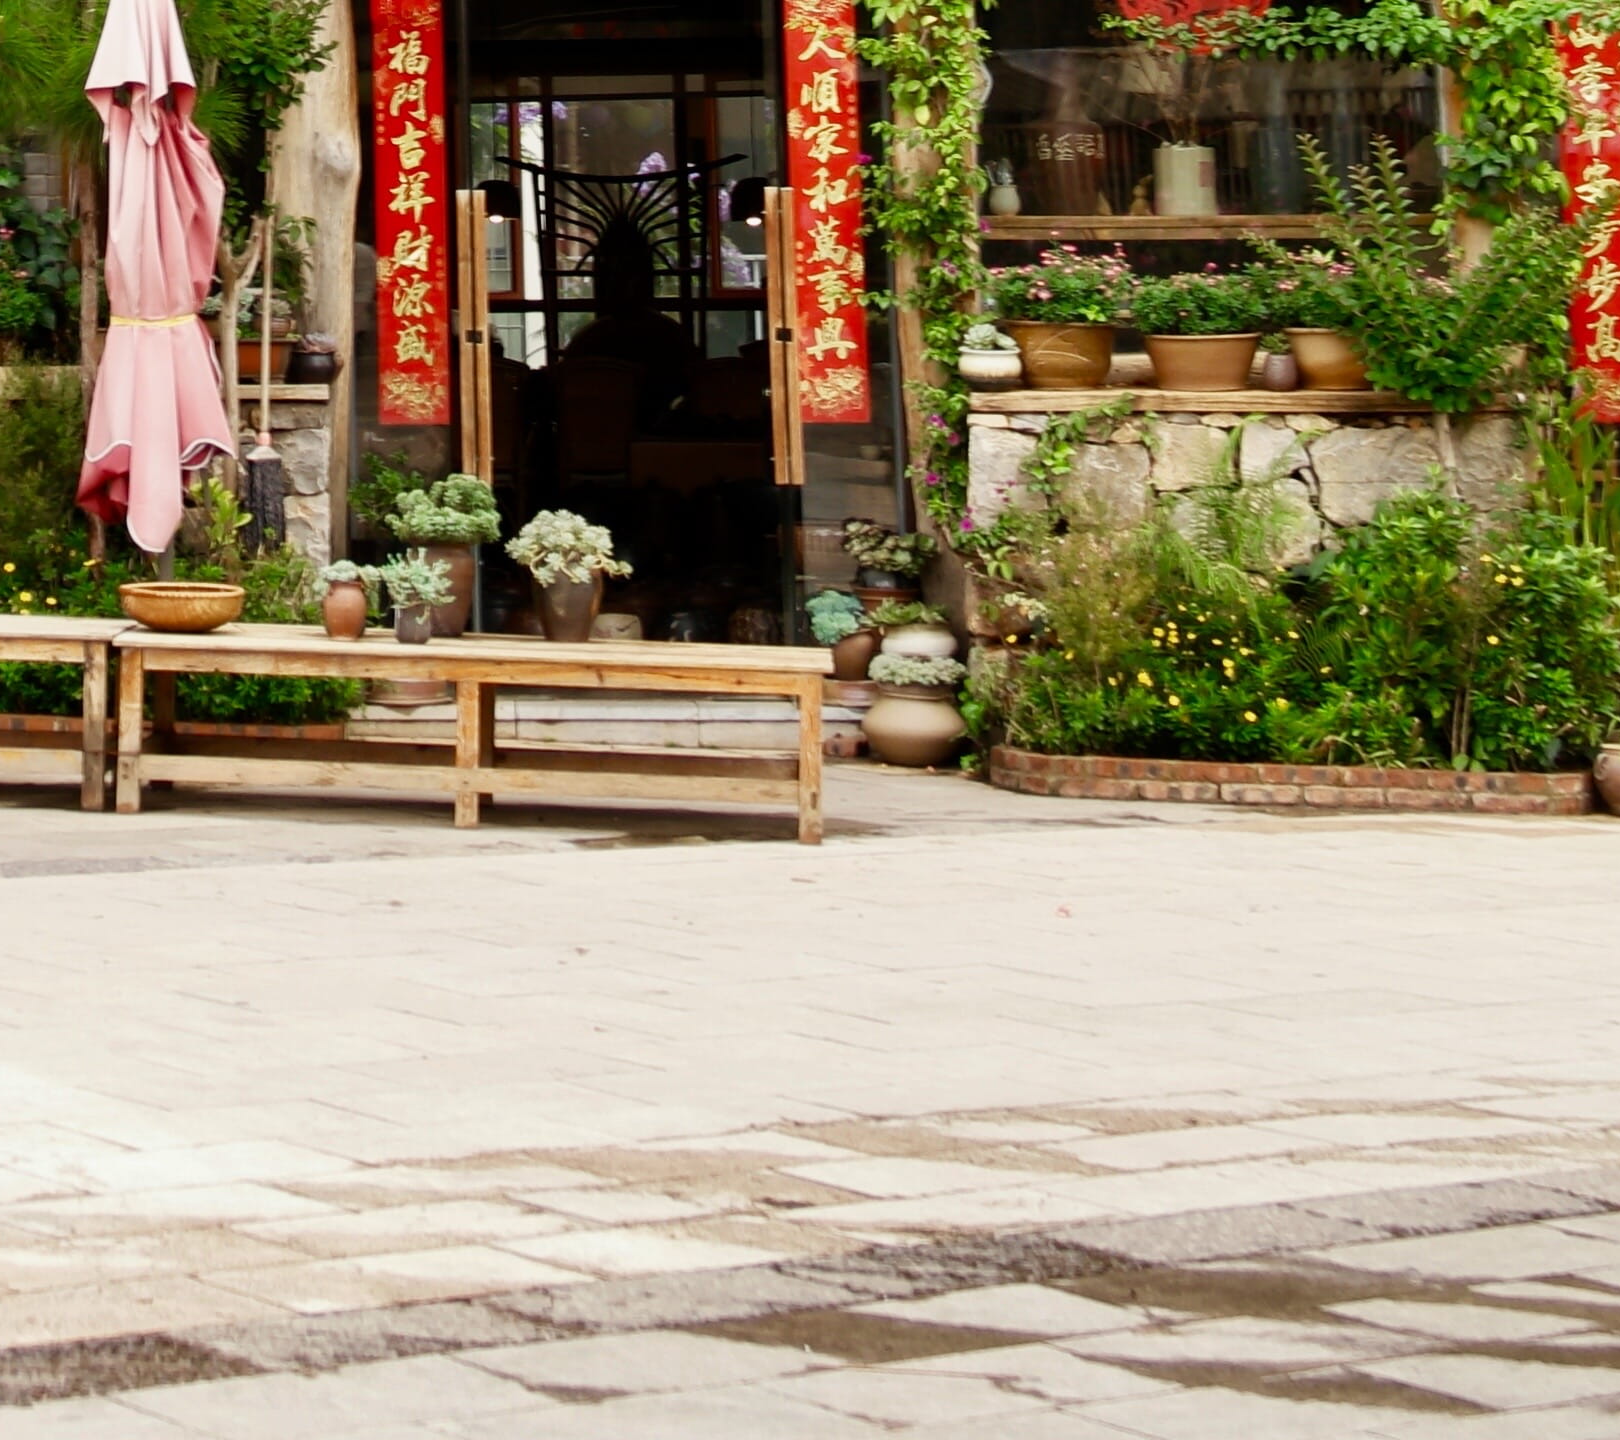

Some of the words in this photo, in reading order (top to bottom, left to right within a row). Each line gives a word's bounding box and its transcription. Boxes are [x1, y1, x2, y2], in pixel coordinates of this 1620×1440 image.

[388, 30, 435, 367] 福門吉祥財源盛
